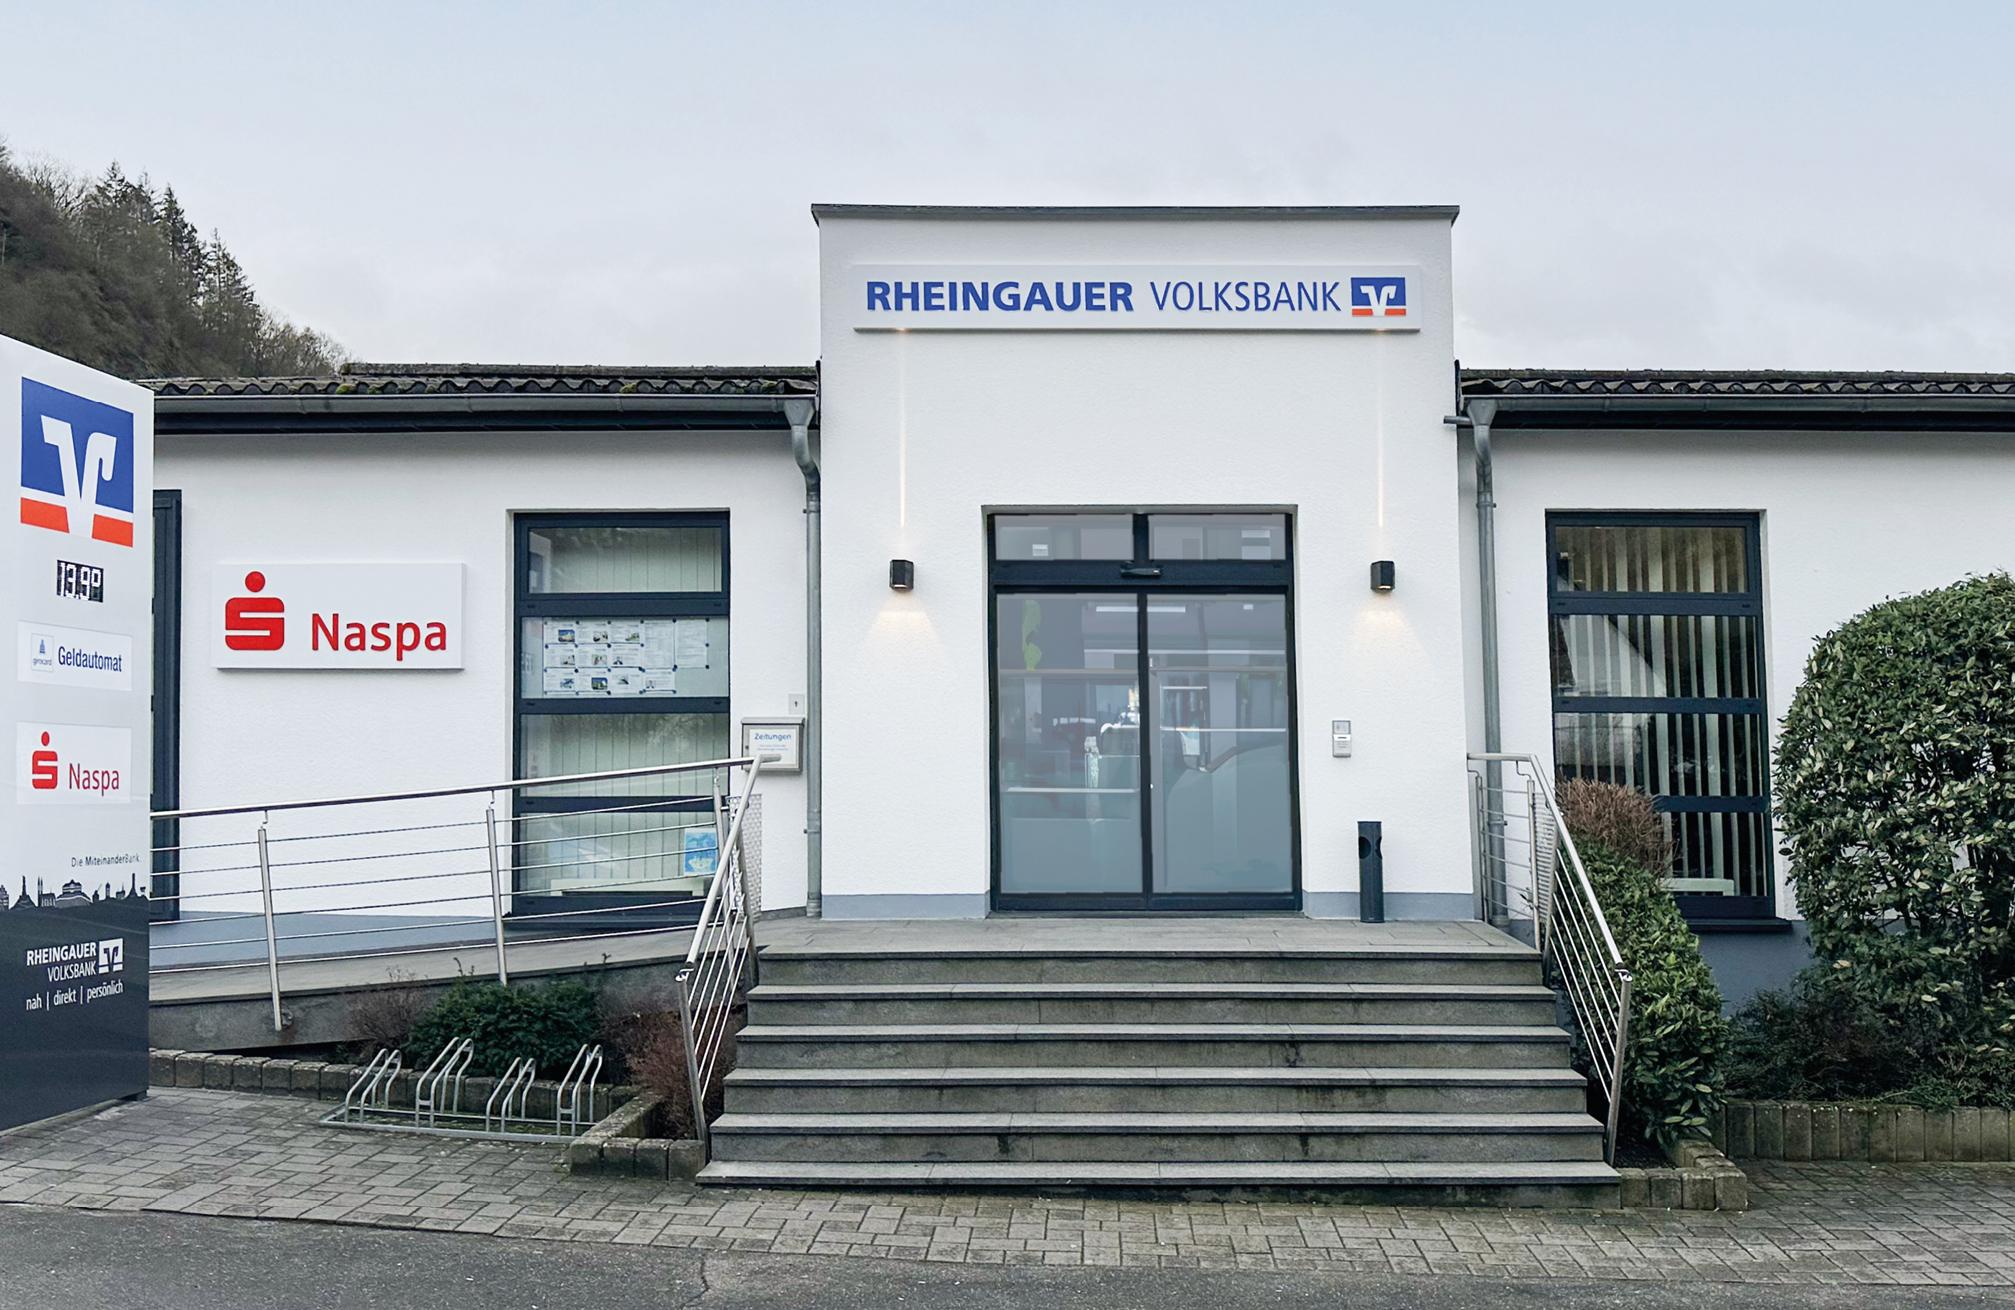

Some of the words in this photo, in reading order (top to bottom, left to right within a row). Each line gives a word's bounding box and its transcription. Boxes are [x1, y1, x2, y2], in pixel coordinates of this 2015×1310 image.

[866, 281, 1134, 312] RHEINGAUER
[1149, 281, 1342, 312] VOLKSBANK
[312, 613, 447, 661] Naspa
[58, 645, 122, 672] Geldautomat
[754, 732, 792, 741] Zeitungen
[69, 763, 120, 796] Naspa
[26, 942, 97, 966] RHEINGAUER
[47, 961, 97, 982] VOLKSBANK
[25, 993, 42, 1011] nah
[53, 987, 77, 1006] direkt
[86, 979, 124, 1003] persönlich
